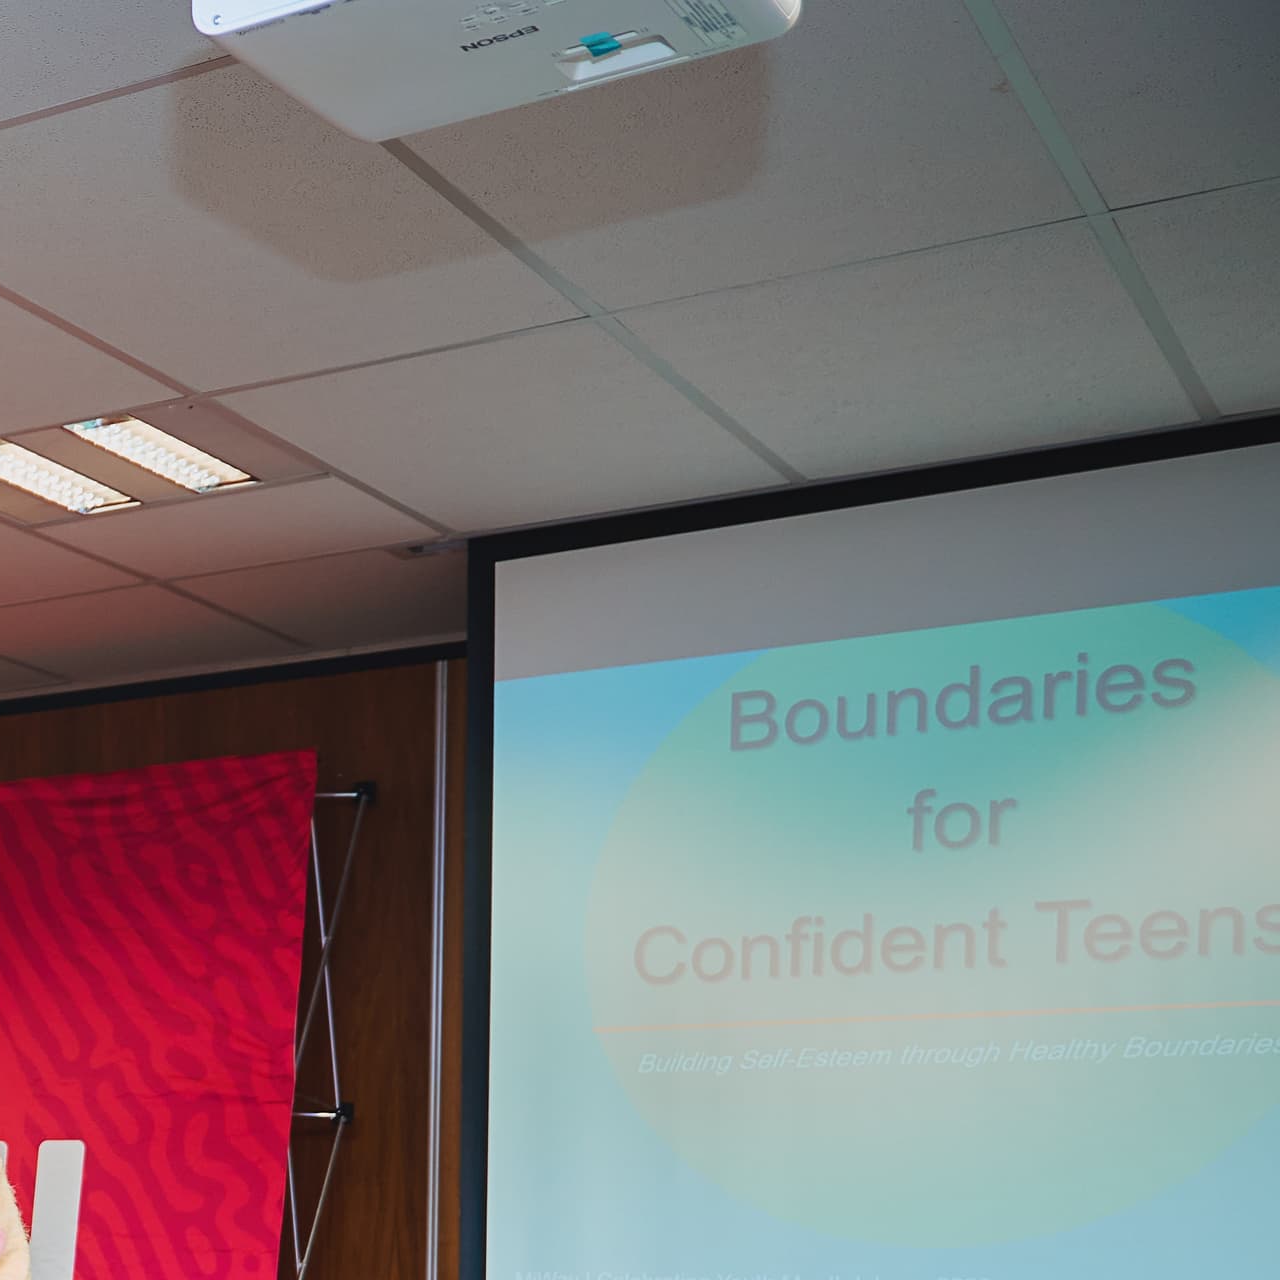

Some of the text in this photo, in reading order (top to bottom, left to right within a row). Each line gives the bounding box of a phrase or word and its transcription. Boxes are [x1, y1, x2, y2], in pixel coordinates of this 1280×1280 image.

[460, 25, 539, 52] EPSON
[729, 652, 1197, 752] Boundaries
[906, 788, 1018, 852] for
[633, 899, 1280, 987] Confident Teens
[638, 1051, 733, 1080] Building
[740, 1047, 893, 1072] Self-Esteem
[901, 1041, 1001, 1068] through
[1008, 1037, 1116, 1064] Healthy
